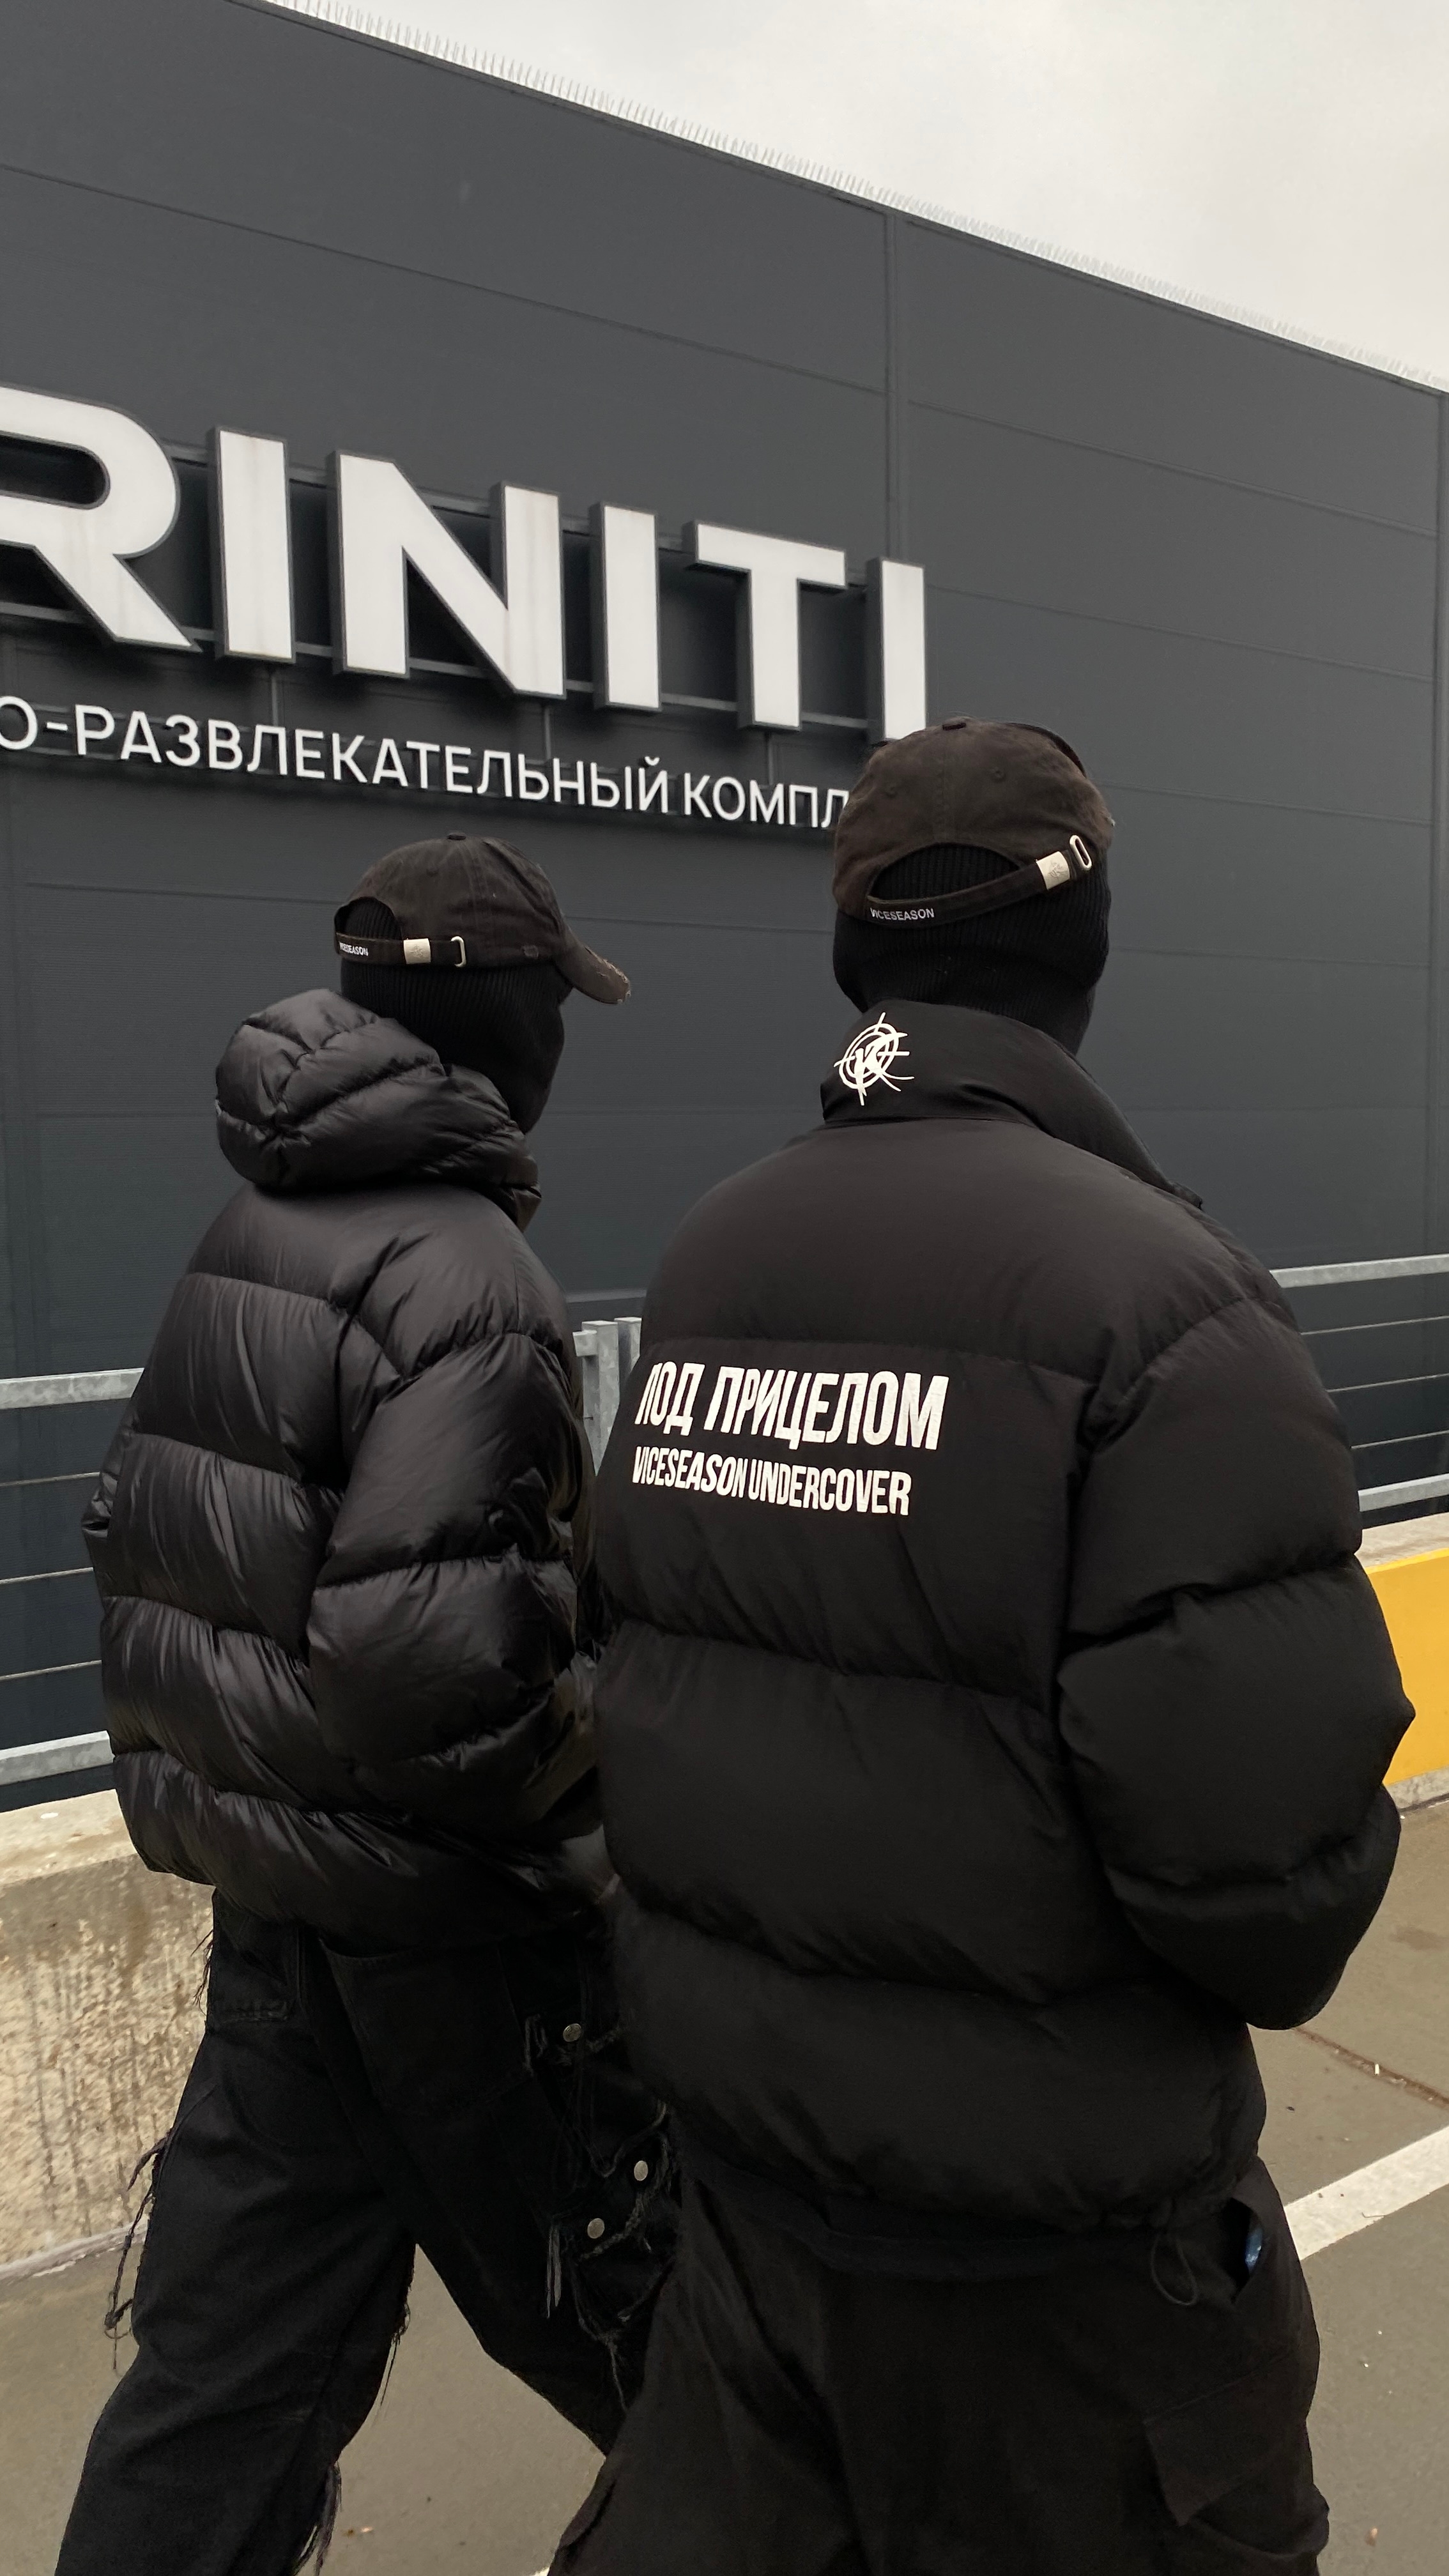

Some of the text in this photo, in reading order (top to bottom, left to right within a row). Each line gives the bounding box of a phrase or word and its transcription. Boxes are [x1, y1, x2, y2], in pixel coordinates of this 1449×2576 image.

[870, 907, 935, 921] VICESEASON
[634, 1361, 949, 1450] ПОД ПРИЦЕЛОМ
[632, 1446, 912, 1516] VICESEASON UNDERCOVER
